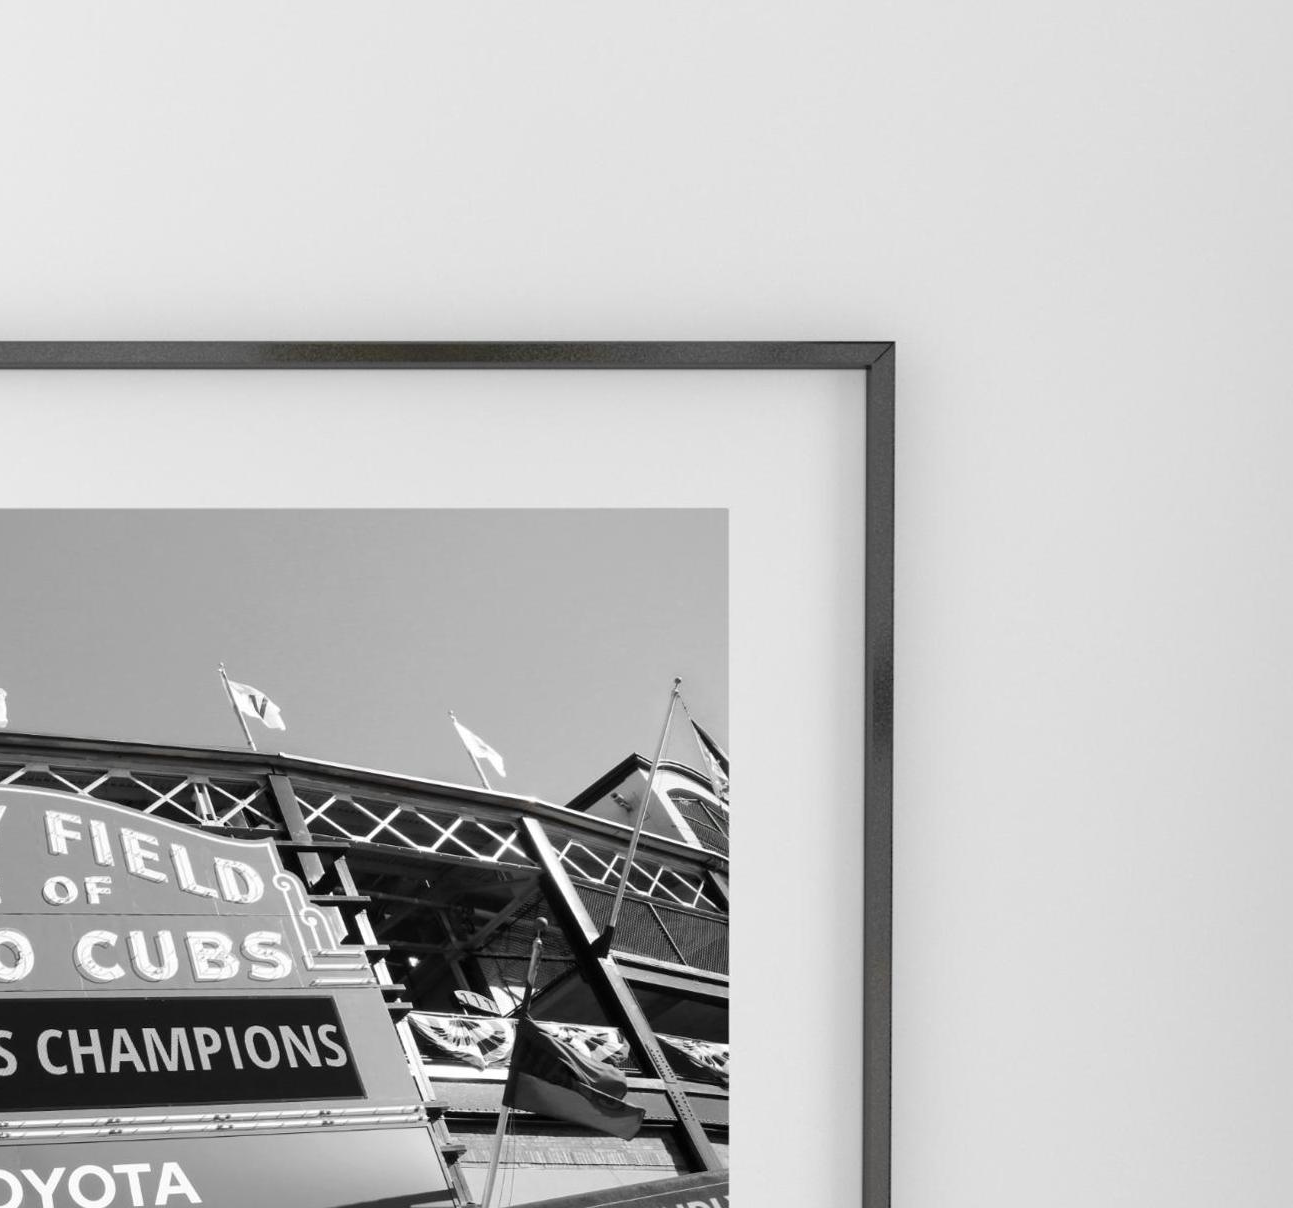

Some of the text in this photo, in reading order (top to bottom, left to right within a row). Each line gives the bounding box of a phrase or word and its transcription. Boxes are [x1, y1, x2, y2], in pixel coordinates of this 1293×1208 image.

[44, 810, 264, 904] FIELD
[42, 875, 112, 906] OF
[73, 930, 293, 983] CUBS
[36, 1023, 348, 1076] CHAMPIONS
